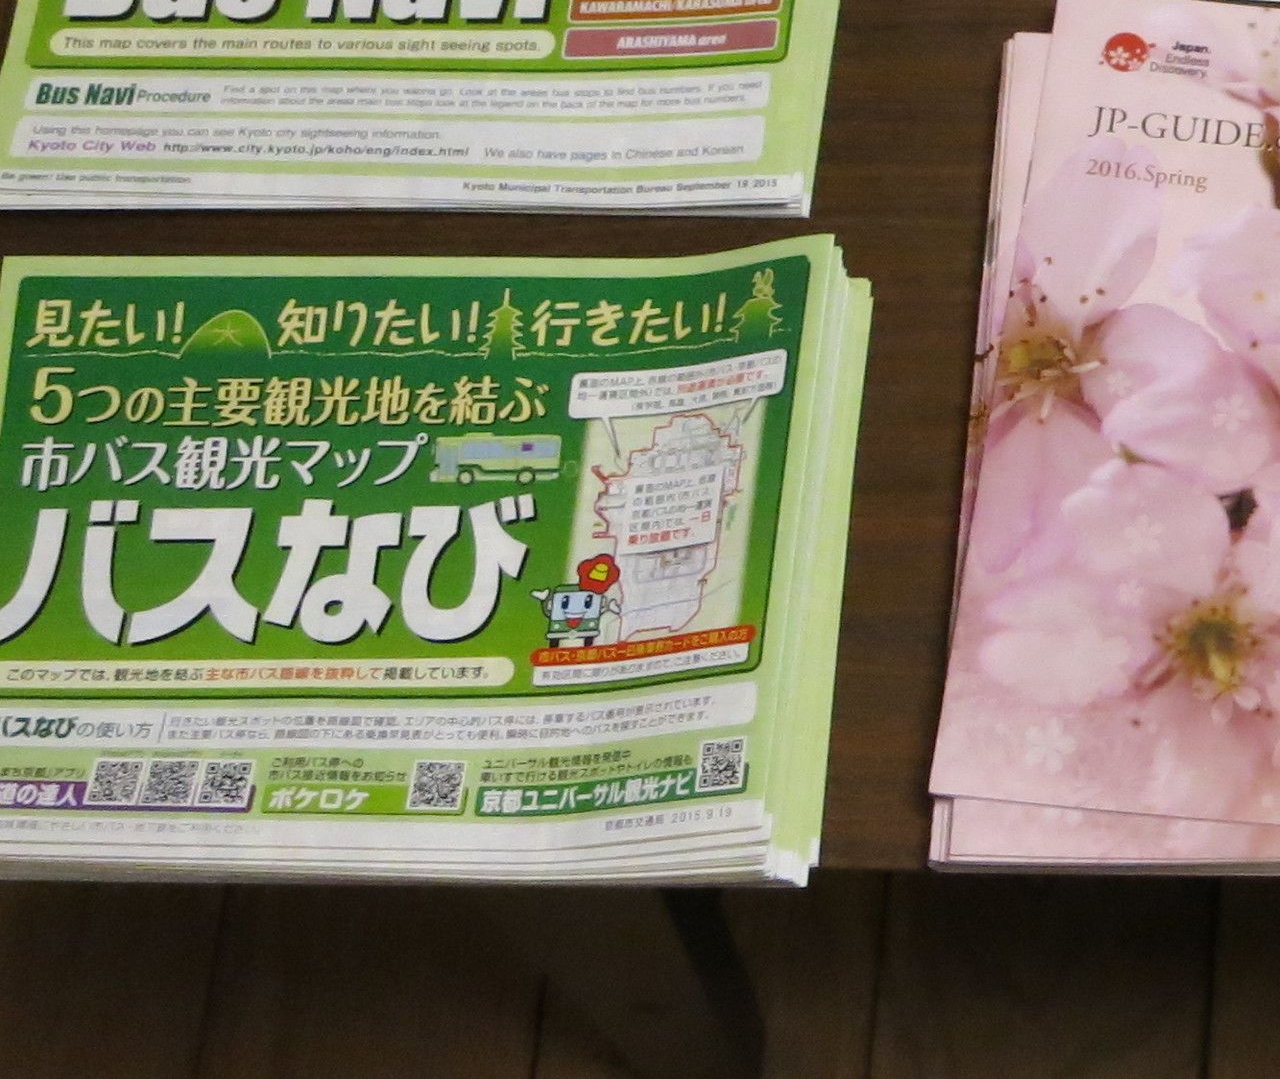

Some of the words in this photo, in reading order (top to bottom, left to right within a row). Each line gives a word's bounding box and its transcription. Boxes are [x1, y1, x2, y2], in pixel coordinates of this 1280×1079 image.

[63, 37, 94, 49] This
[99, 38, 131, 51] map
[137, 38, 187, 49] covers
[192, 37, 216, 50] the
[222, 38, 257, 50] main
[262, 38, 312, 51] routes
[318, 39, 332, 51] to
[337, 38, 392, 51] various
[398, 37, 435, 53] sight
[441, 38, 491, 55] seeing
[496, 38, 540, 54] spots.
[1173, 40, 1211, 55] Japan.
[1165, 53, 1210, 68] Endless
[36, 83, 79, 104] Bus
[84, 83, 135, 106] Navi
[138, 90, 211, 103] Procedure
[29, 140, 77, 154] Kyoto
[82, 140, 112, 154] City
[121, 140, 156, 152] Web
[677, 181, 732, 192] September
[753, 178, 777, 188] 2015
[1086, 159, 1208, 194] 2016.Spring
[27, 299, 184, 348] 見たい!
[276, 301, 480, 348] 知りたい!
[532, 293, 726, 344] 行きたい!
[30, 368, 549, 425] 5つの主要観光地を結ぶ
[20, 432, 428, 490] 市バス観光マップ
[0, 494, 537, 646] バスなび
[270, 788, 370, 810] ポケロケ
[481, 772, 691, 814] 京都ユニバーサル観光ナビ
